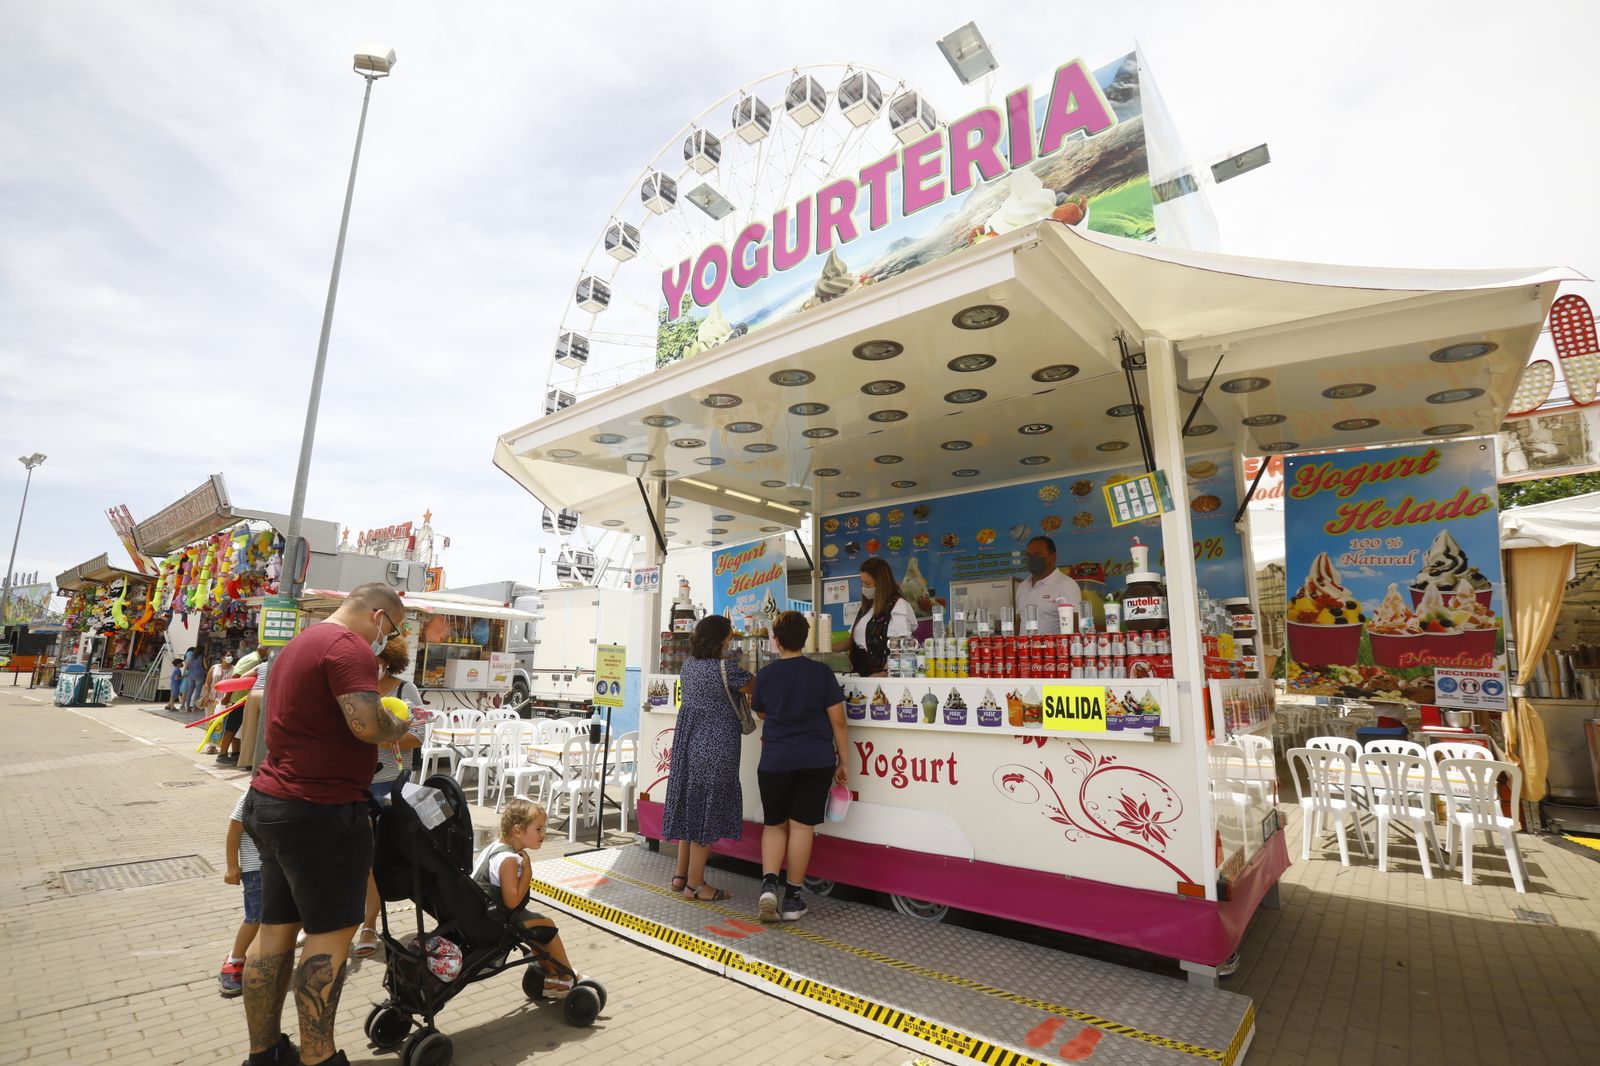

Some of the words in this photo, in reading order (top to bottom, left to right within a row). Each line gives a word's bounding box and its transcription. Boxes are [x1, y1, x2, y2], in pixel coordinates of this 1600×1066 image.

[661, 58, 1118, 322] YOGURTERIA
[1290, 448, 1442, 499] Yogurt
[1324, 487, 1493, 535] Helado
[1350, 538, 1381, 549] 100
[1386, 537, 1403, 549] %
[715, 541, 767, 576] Yogurt
[1341, 550, 1419, 566] Natural
[727, 563, 783, 597] Helado
[1127, 597, 1160, 608] nutella
[1399, 650, 1493, 668] ¡Novedad!
[1437, 669, 1501, 679] RECUERDE
[1045, 695, 1102, 720] SALIDA
[853, 741, 958, 789] Yogurt
[809, 987, 832, 999] DISTANCIA
[839, 997, 864, 1010] SEGURIDAD
[904, 1020, 931, 1037] DISTANCIA
[931, 1030, 939, 1039] DE
[940, 1032, 971, 1050] SEGURIDAD
